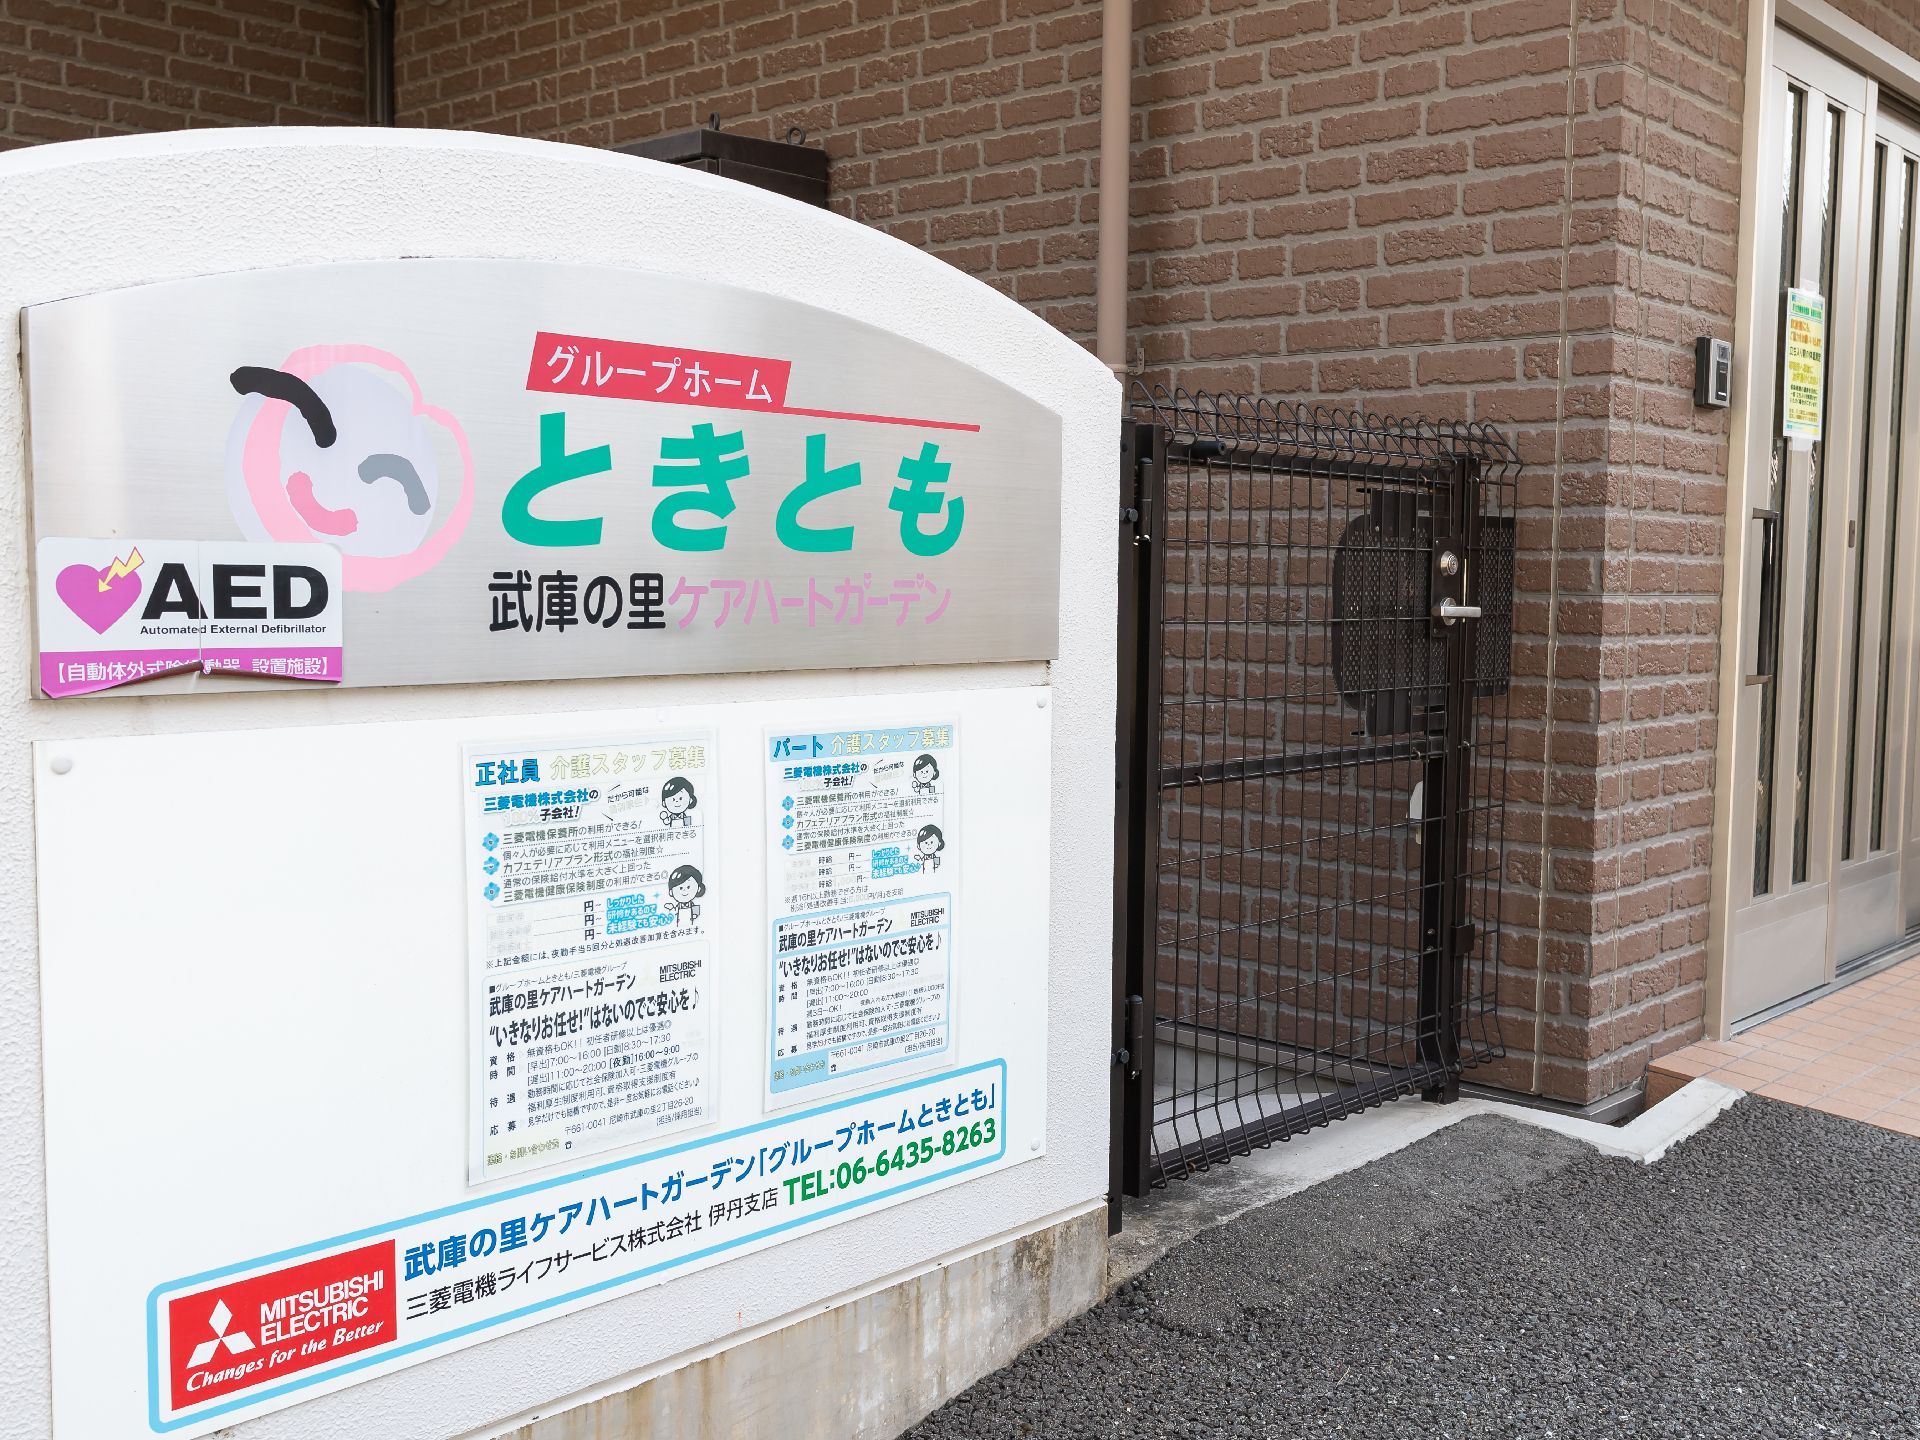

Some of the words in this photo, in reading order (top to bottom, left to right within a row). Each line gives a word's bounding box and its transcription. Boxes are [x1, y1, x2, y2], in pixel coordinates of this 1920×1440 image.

[546, 344, 774, 404] グループホーム
[501, 411, 965, 557] ときとも
[140, 562, 329, 620] AED
[140, 624, 207, 635] Automated
[210, 623, 258, 634] External
[261, 623, 327, 634] Defibrillator
[773, 735, 824, 758] パート
[830, 727, 950, 756] 介護スタッフ募集
[474, 757, 541, 787] 正社員
[549, 745, 706, 781] 介護スタッフ募集
[483, 788, 599, 813] 三菱電機株式会社の
[778, 918, 893, 952] 武庫の里ケアハートガーデン
[910, 907, 945, 919] MITSUBISHI
[910, 916, 939, 928] ELECTRIC
[659, 959, 702, 975] MITSUBISHI
[659, 966, 697, 983] ELECTRIC
[489, 973, 637, 1018] 武庫の里ケアハートガーデン
[404, 1083, 997, 1281] 武庫の里ケアハートガーデン「グループホームときとも」
[783, 1117, 996, 1206] TEL:06-6435-8263
[405, 1209, 702, 1320] 三菱電機ライフサービス株式会社
[708, 1187, 779, 1228] 伊丹支店
[260, 1269, 385, 1325] MITSUBISHI
[260, 1296, 369, 1347] ELECTRIC
[185, 1358, 265, 1392] Changes
[268, 1347, 296, 1370] for
[300, 1336, 328, 1357] the
[332, 1320, 385, 1348] Better
